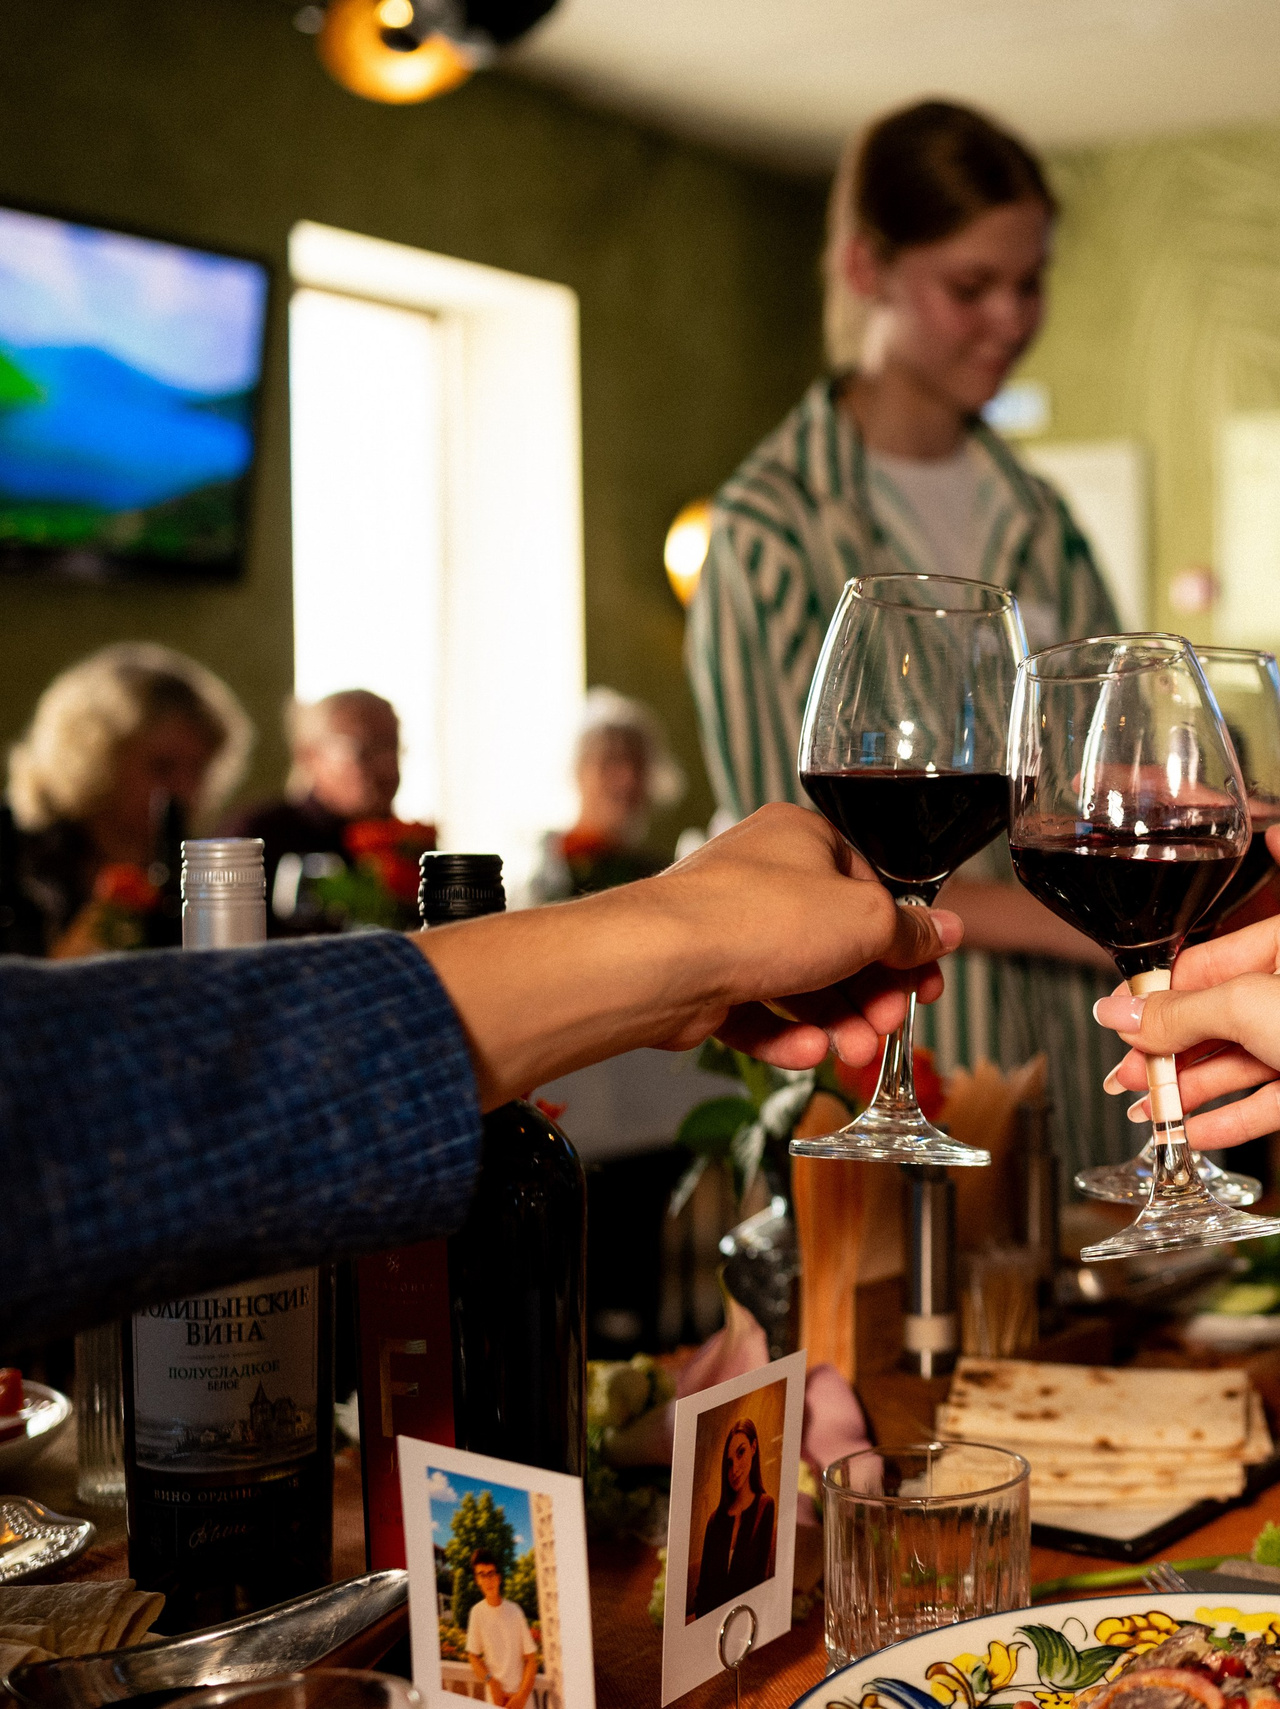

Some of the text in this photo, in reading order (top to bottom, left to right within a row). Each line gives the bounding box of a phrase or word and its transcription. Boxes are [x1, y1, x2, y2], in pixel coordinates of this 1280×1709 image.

[186, 1320, 265, 1346] ВИНА
[168, 1359, 281, 1380] ПОЛУСЛАДКОЕ
[207, 1378, 240, 1391] БЕЛОЕ
[153, 1487, 192, 1504] ВИНО
